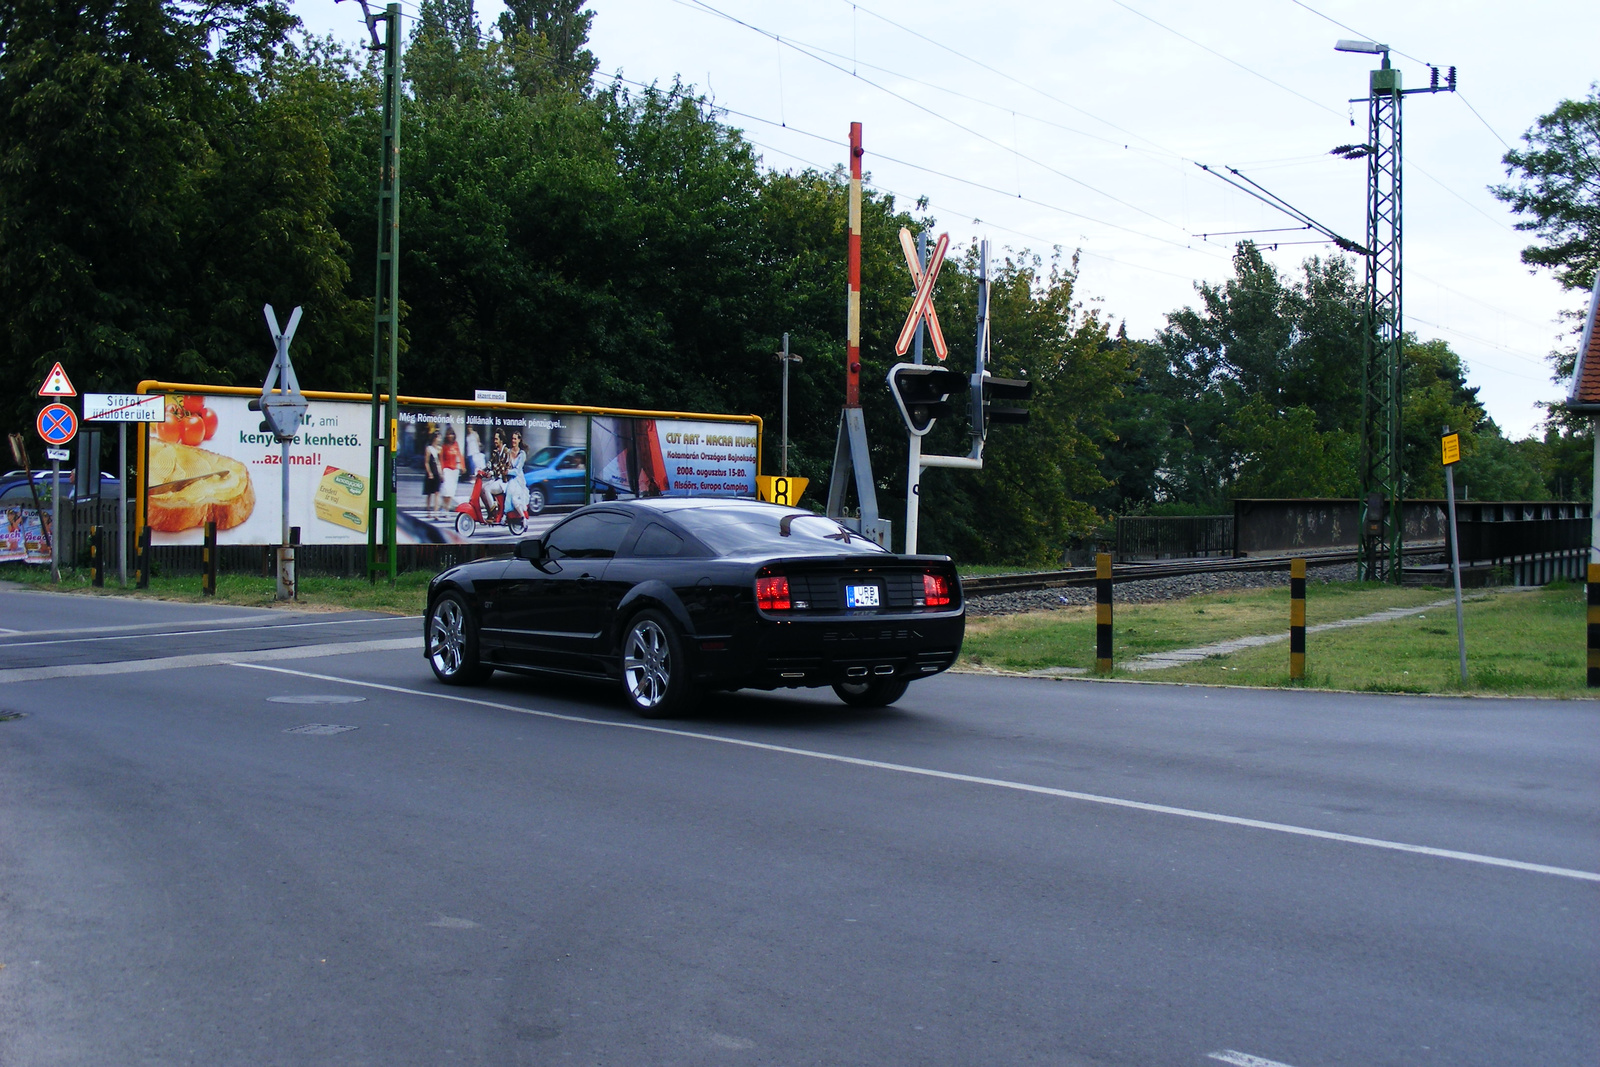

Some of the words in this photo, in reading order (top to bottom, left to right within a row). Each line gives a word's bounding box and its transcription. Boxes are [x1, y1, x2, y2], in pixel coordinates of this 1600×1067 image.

[319, 415, 339, 427] ami
[399, 412, 416, 424] Még
[417, 413, 455, 424] Rómeónak
[456, 415, 465, 424] és
[466, 415, 494, 425] Júliának
[495, 416, 502, 425] is
[502, 417, 527, 427] vannak
[304, 431, 362, 447] kenhető.
[666, 432, 682, 445] CUT
[683, 432, 700, 446] ART
[735, 436, 757, 448] KUPA
[667, 450, 699, 460] Katamarán
[700, 452, 727, 463] Országos
[676, 466, 695, 476] 2008.
[696, 468, 727, 478] augusztus
[728, 468, 747, 478] 15-20.
[700, 481, 722, 492] Europa
[722, 482, 749, 493] Camping
[775, 477, 788, 505] 8
[858, 586, 875, 596] URB
[860, 596, 875, 605] 475
